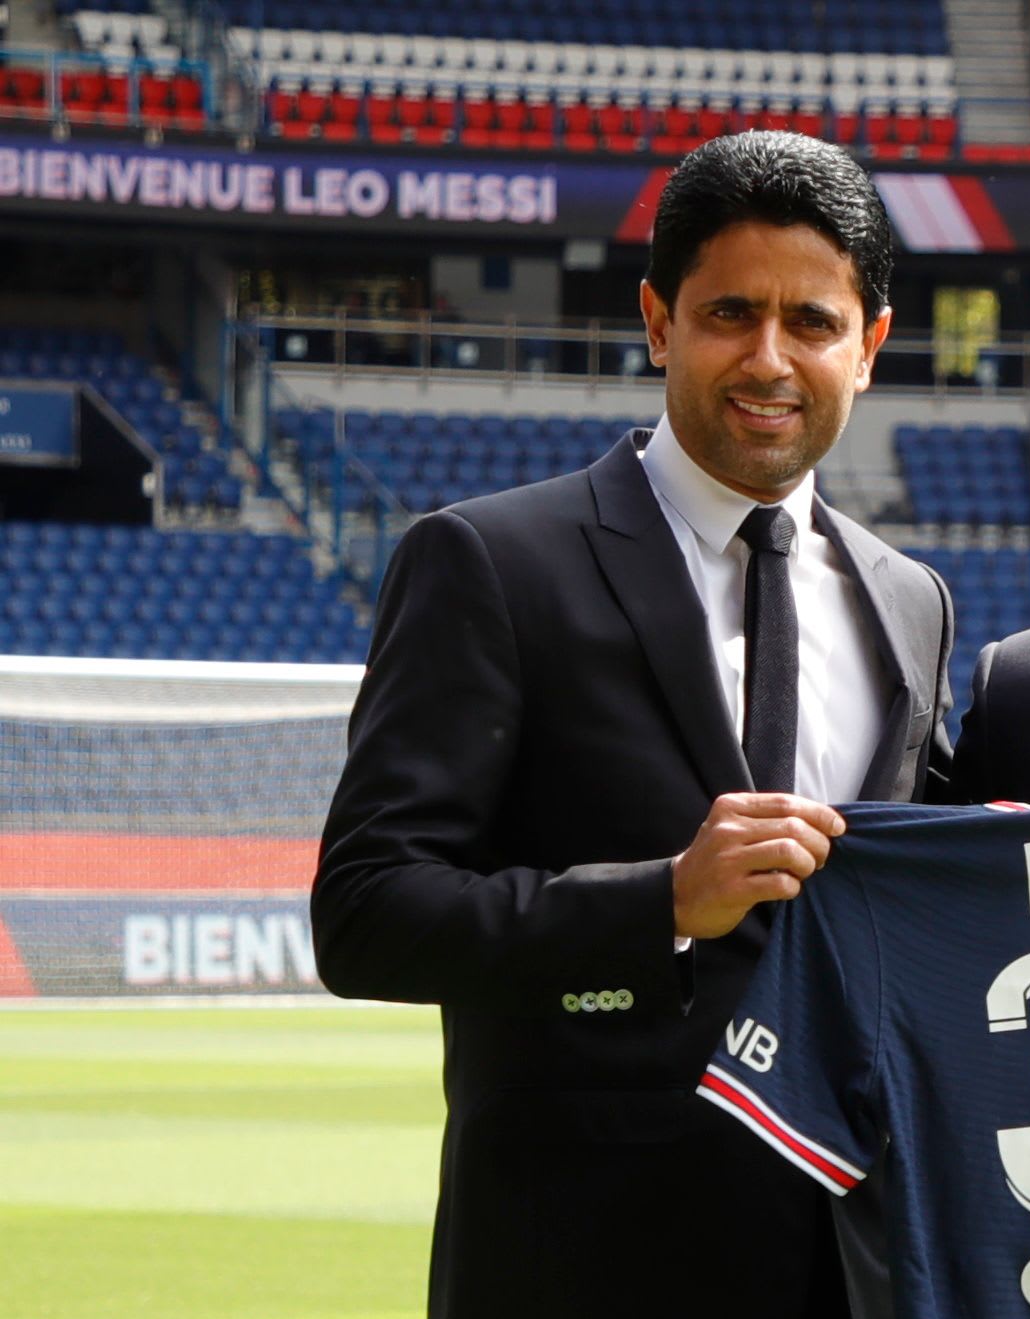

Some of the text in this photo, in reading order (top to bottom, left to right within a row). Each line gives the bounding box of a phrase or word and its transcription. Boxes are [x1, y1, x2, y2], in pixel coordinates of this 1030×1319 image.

[0, 148, 557, 224] BIENVENUE LEO MESSI
